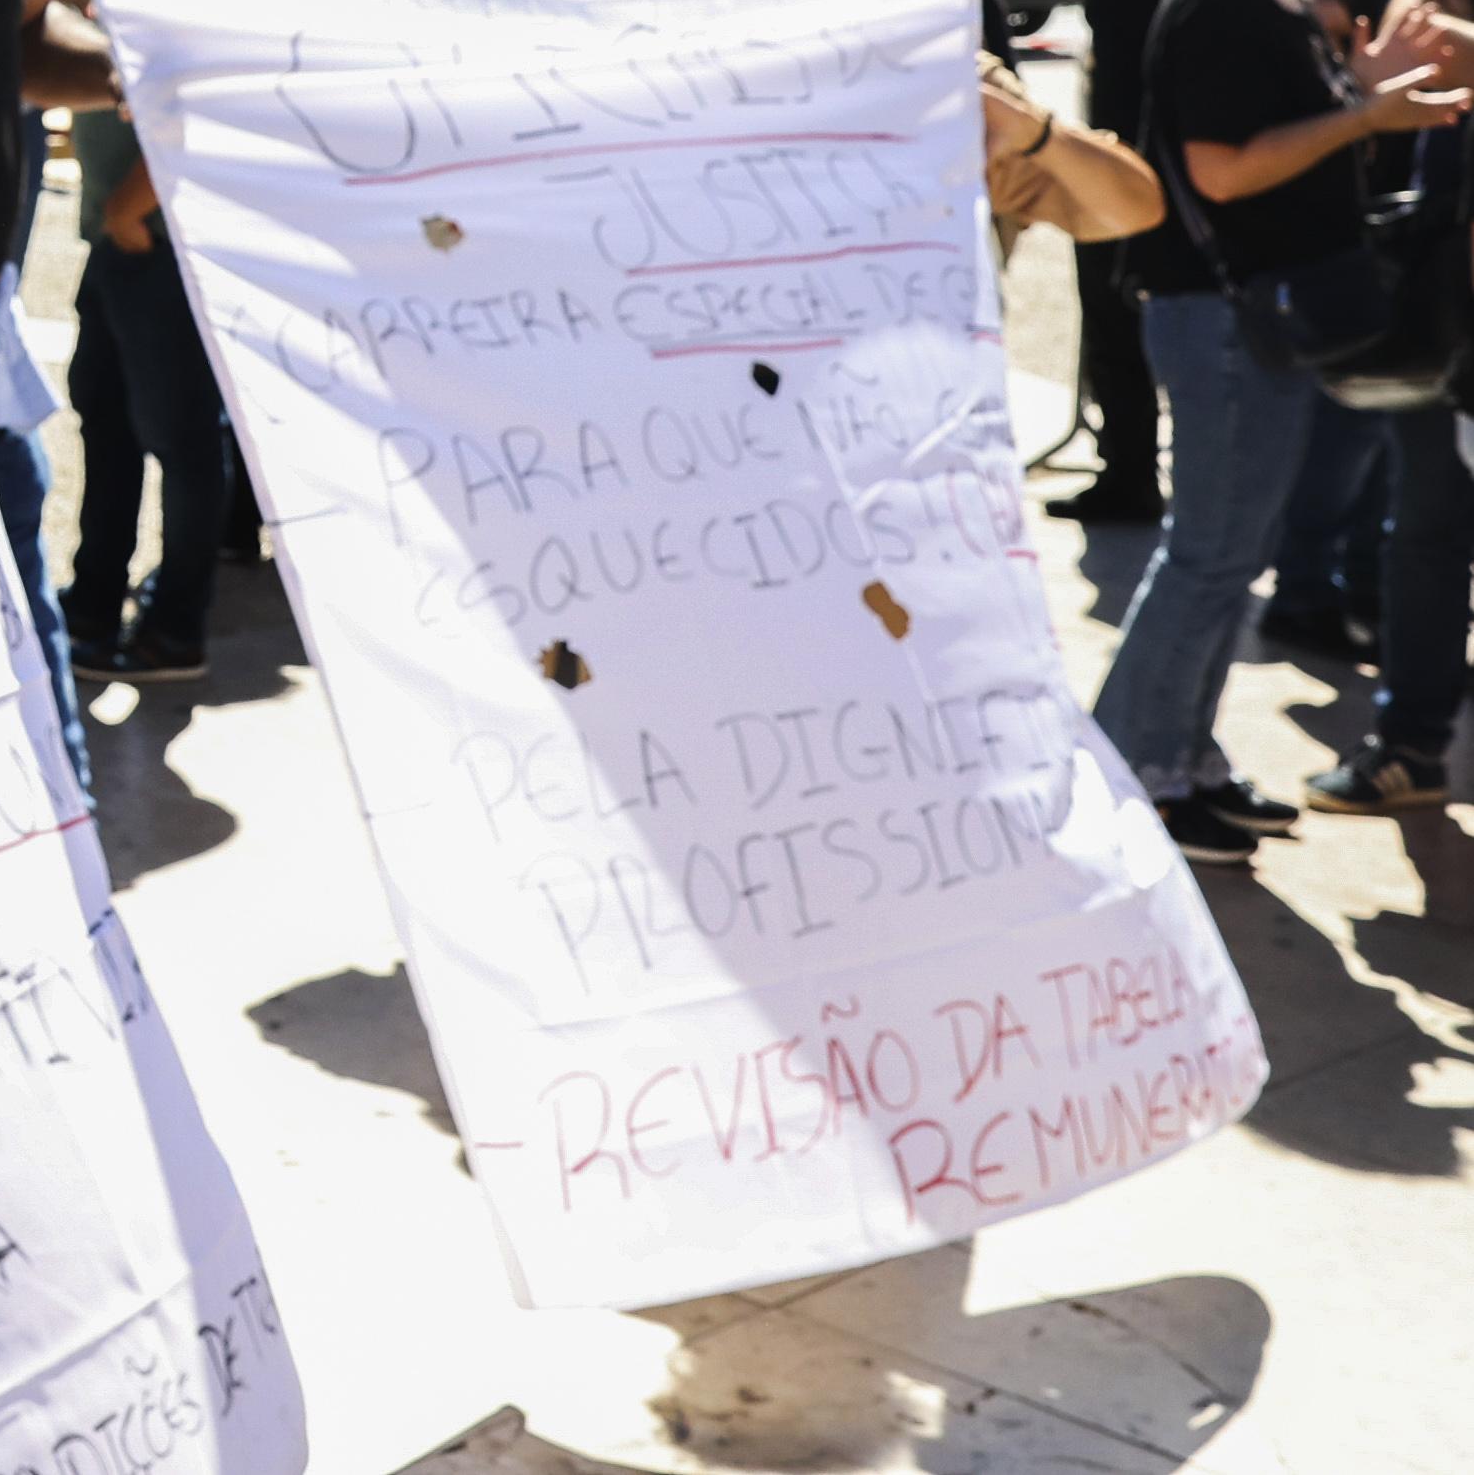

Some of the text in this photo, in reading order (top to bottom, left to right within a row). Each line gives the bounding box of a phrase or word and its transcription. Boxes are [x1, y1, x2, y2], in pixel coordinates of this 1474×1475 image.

[376, 416, 628, 548] PARA
[641, 400, 787, 486] QUE
[537, 994, 921, 1214] REVISÃO
[934, 992, 1043, 1104] DA
